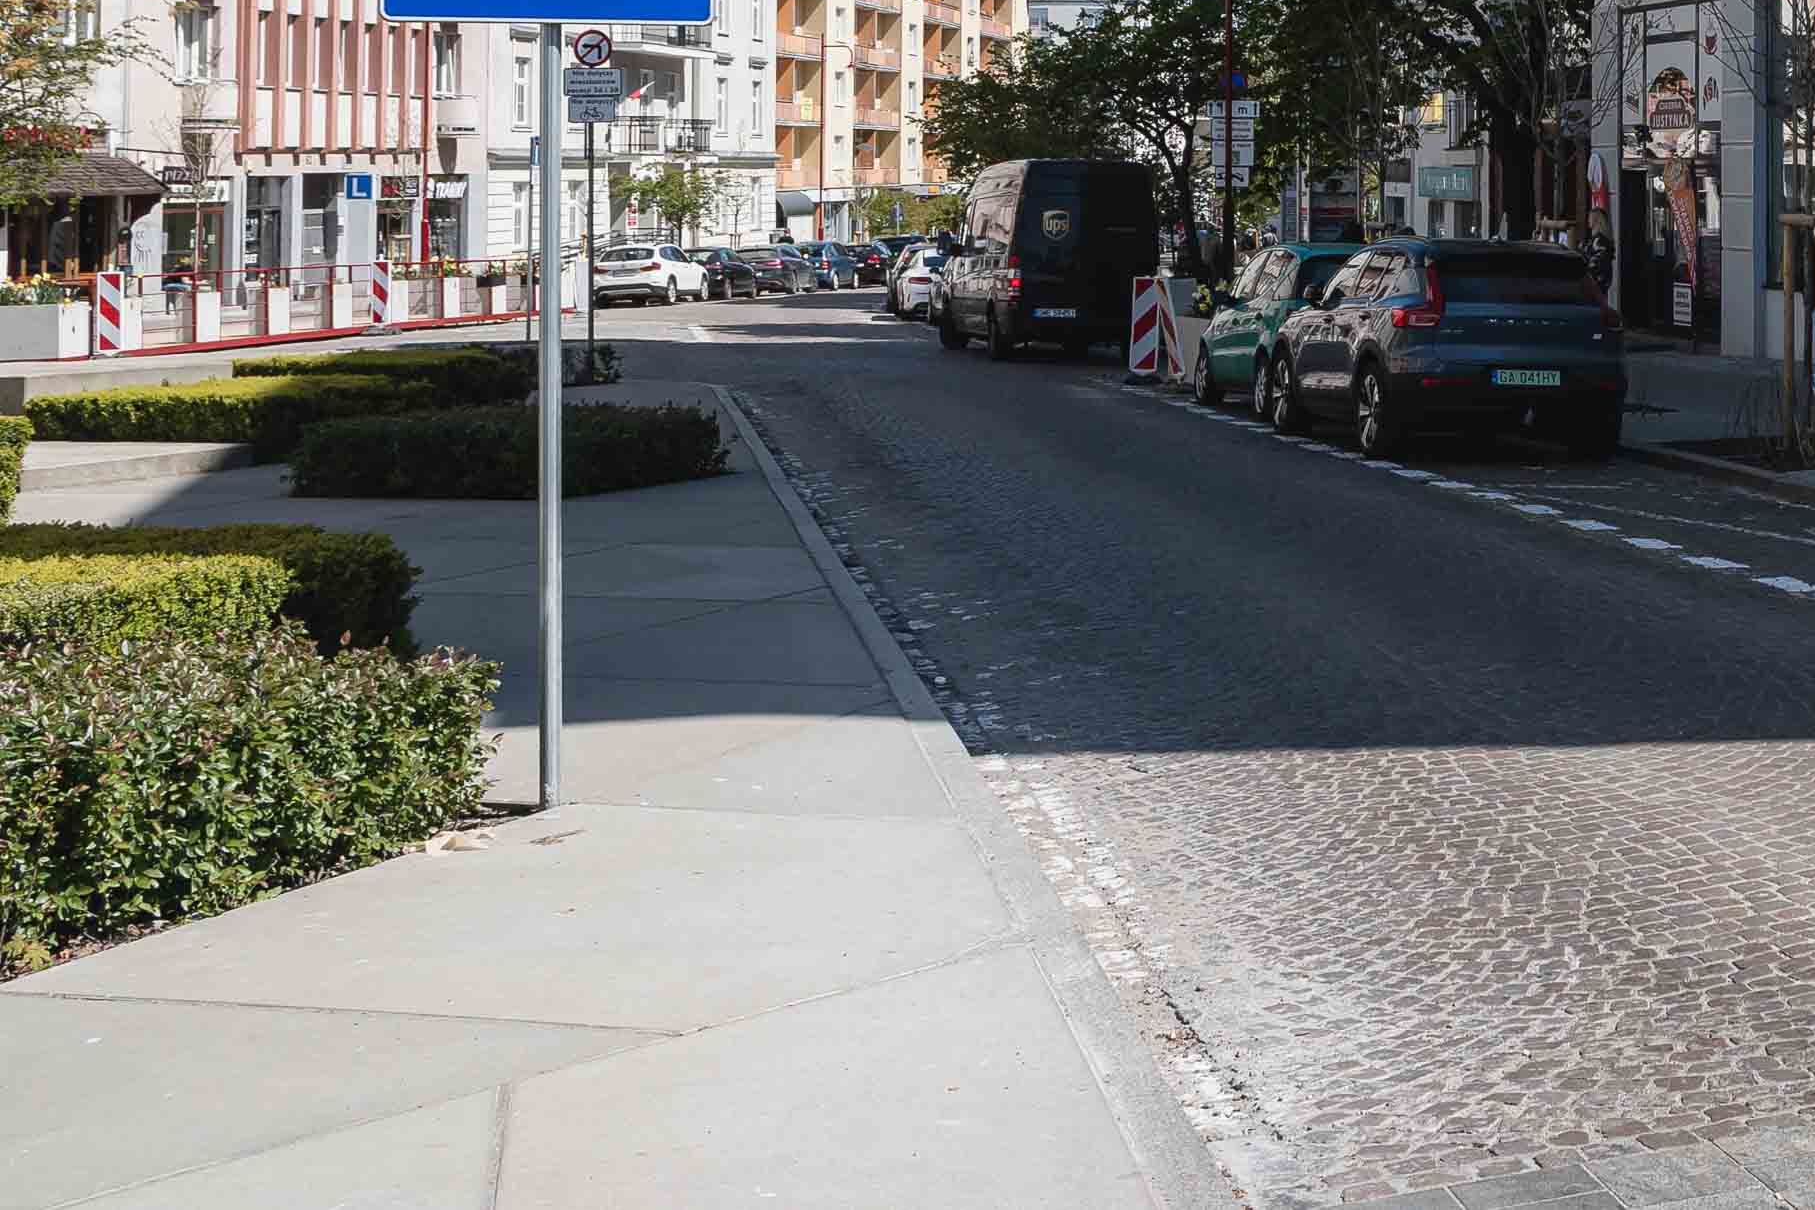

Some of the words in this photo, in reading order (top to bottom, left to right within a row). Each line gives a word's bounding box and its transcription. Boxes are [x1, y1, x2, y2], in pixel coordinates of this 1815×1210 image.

[1651, 113, 1690, 128] JUSTYNKA
[351, 177, 368, 197] L
[1500, 371, 1516, 385] GA
